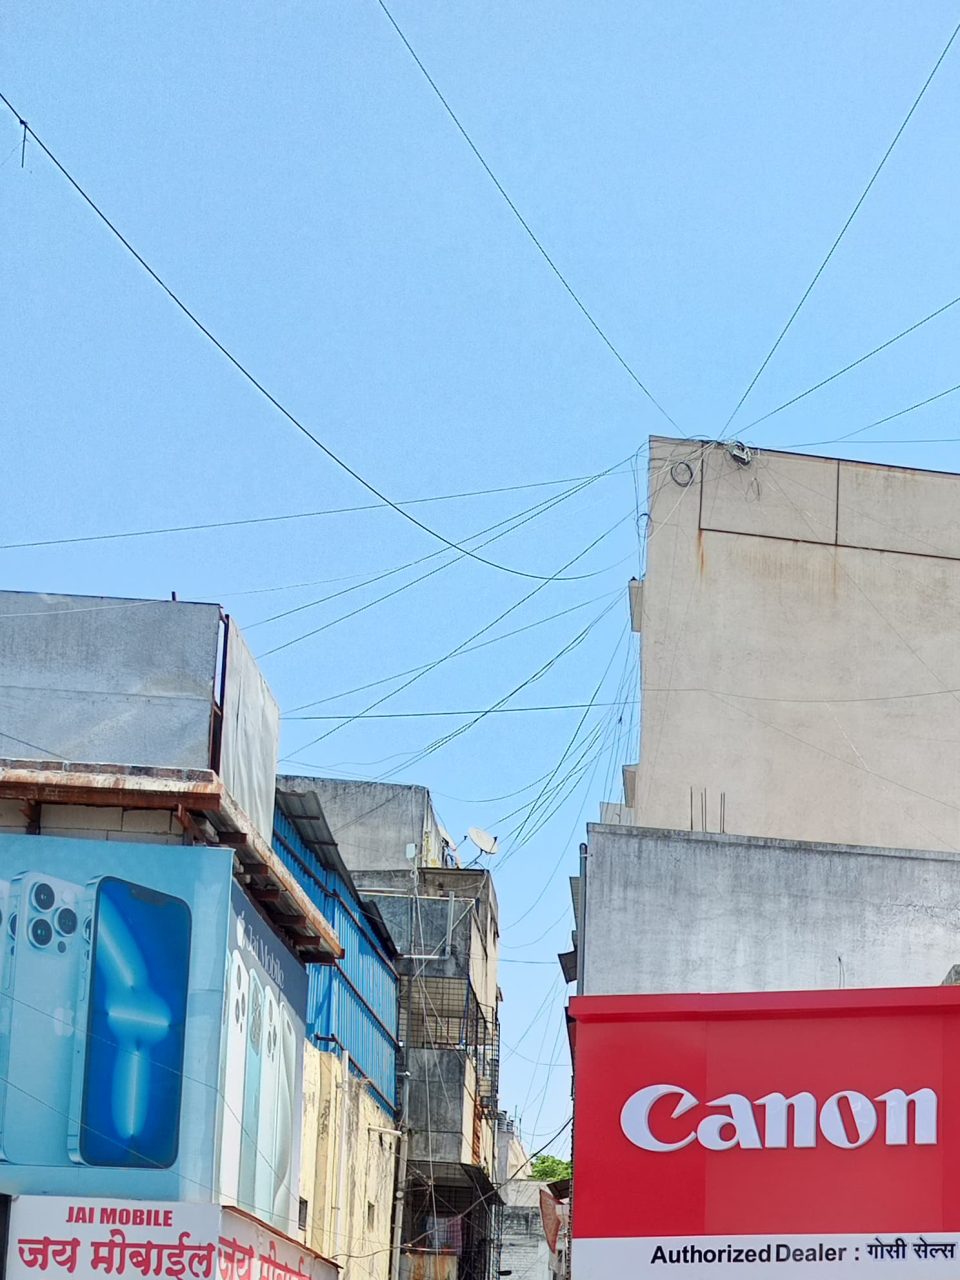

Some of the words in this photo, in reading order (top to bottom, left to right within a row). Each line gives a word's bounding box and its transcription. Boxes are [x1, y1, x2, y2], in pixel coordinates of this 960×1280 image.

[620, 1083, 937, 1153] Canon
[66, 1206, 95, 1224] JAI
[100, 1208, 173, 1227] MOBILE
[18, 1236, 81, 1273] जय
[650, 1244, 772, 1265] Authorized
[776, 1243, 847, 1263] Dealer
[867, 1238, 907, 1259] गोसी
[914, 1237, 955, 1259] सेल्स
